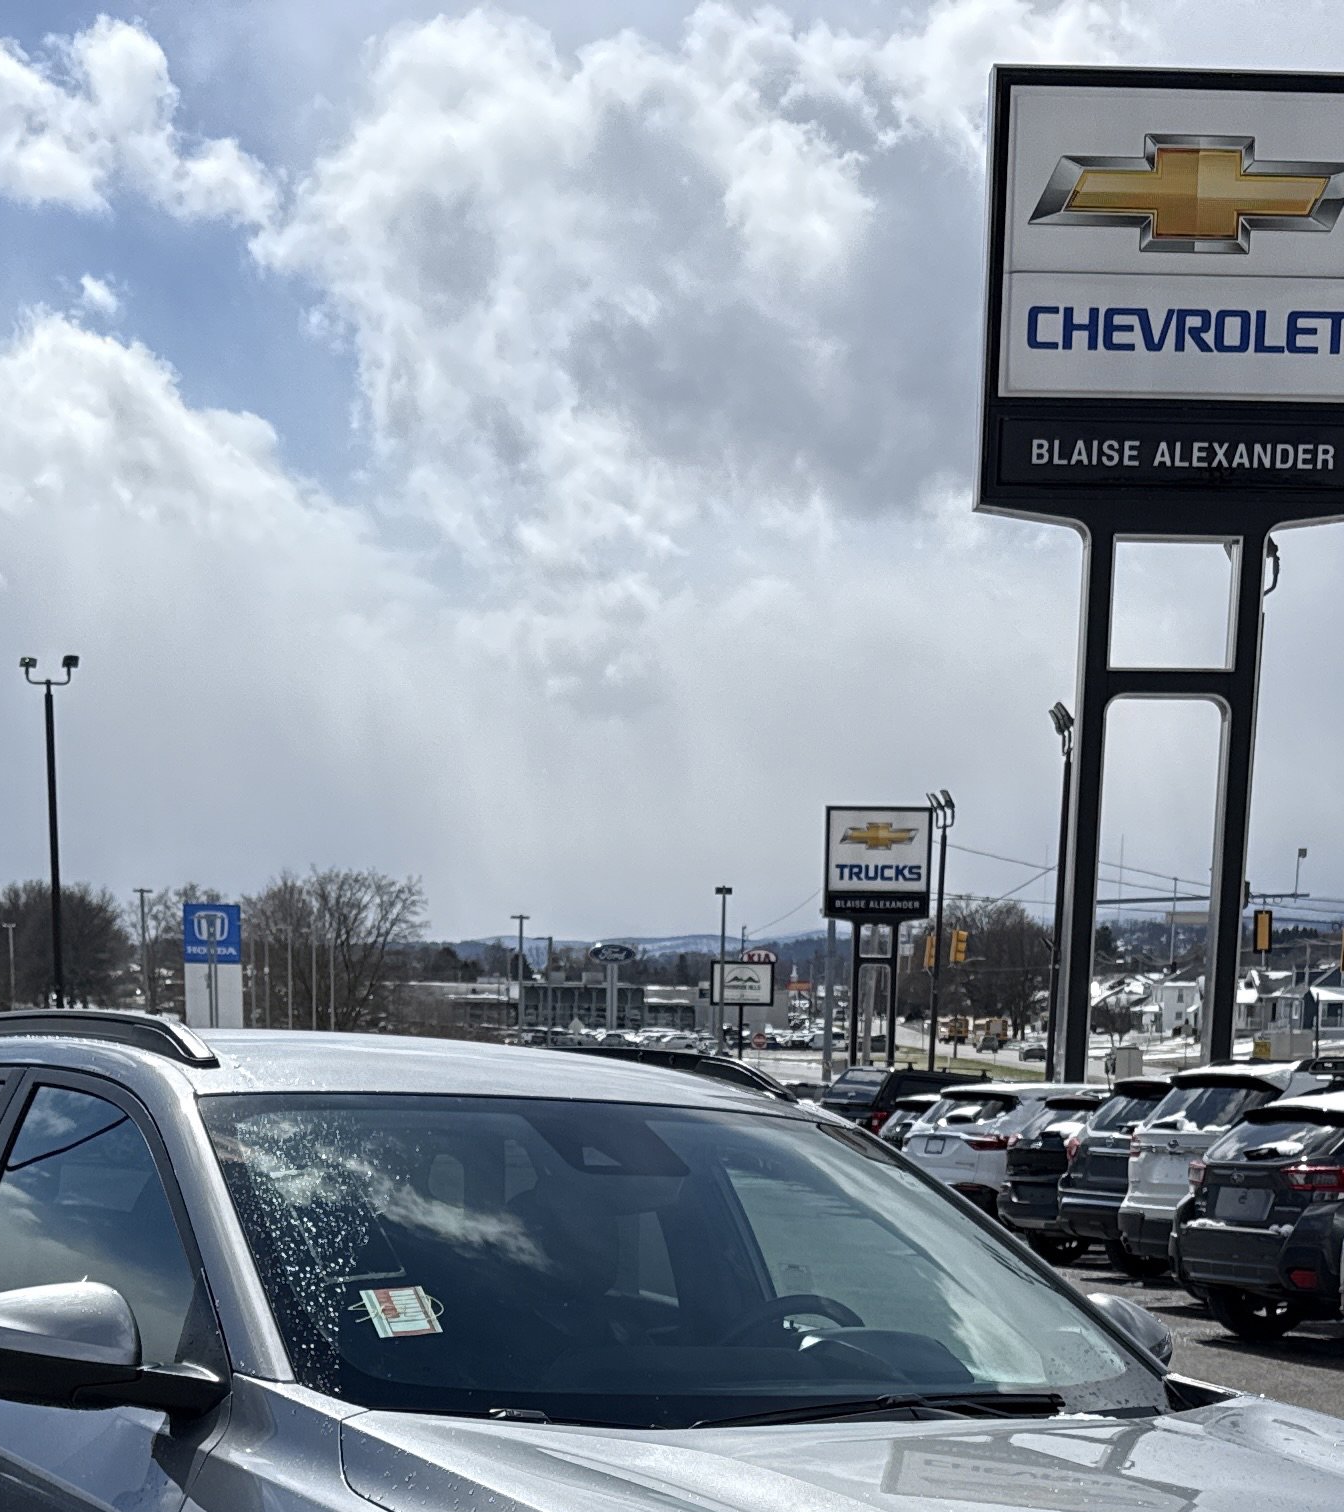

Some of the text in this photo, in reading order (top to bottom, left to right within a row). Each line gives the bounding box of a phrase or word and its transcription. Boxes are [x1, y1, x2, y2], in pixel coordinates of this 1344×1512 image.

[1030, 438, 1336, 471] BLAISE ALEXANDER
[834, 863, 922, 882] TRUCKS
[835, 899, 921, 909] BLAISE ALEXANDER
[746, 952, 772, 962] KIA
